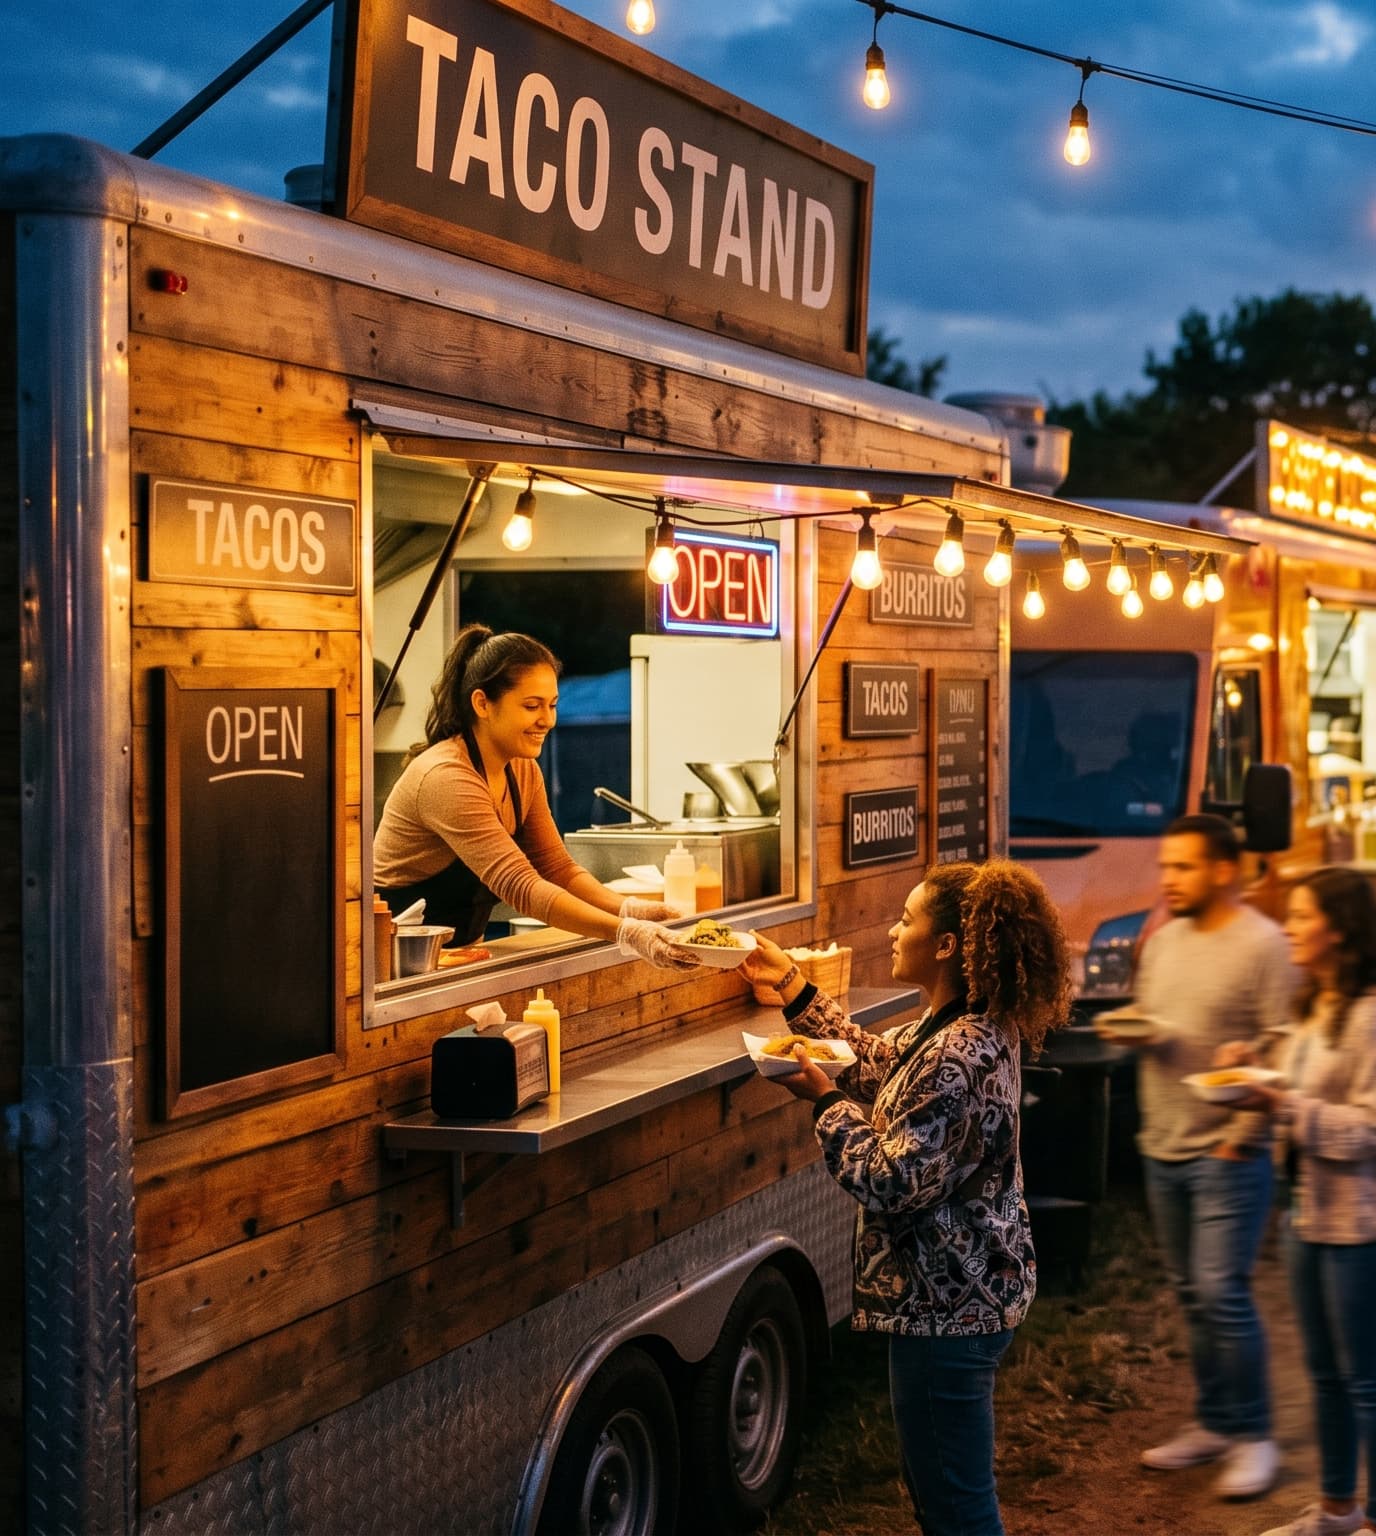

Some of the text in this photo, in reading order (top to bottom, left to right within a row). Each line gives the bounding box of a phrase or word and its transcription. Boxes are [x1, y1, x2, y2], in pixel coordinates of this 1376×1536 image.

[406, 14, 836, 310] TACO STAND
[187, 498, 326, 575] TACOS
[668, 544, 771, 624] OPEN
[880, 569, 966, 619] BURRITOS
[862, 680, 908, 716] TACOS
[206, 705, 304, 764] OPEN
[853, 805, 914, 845] BURRITOS
